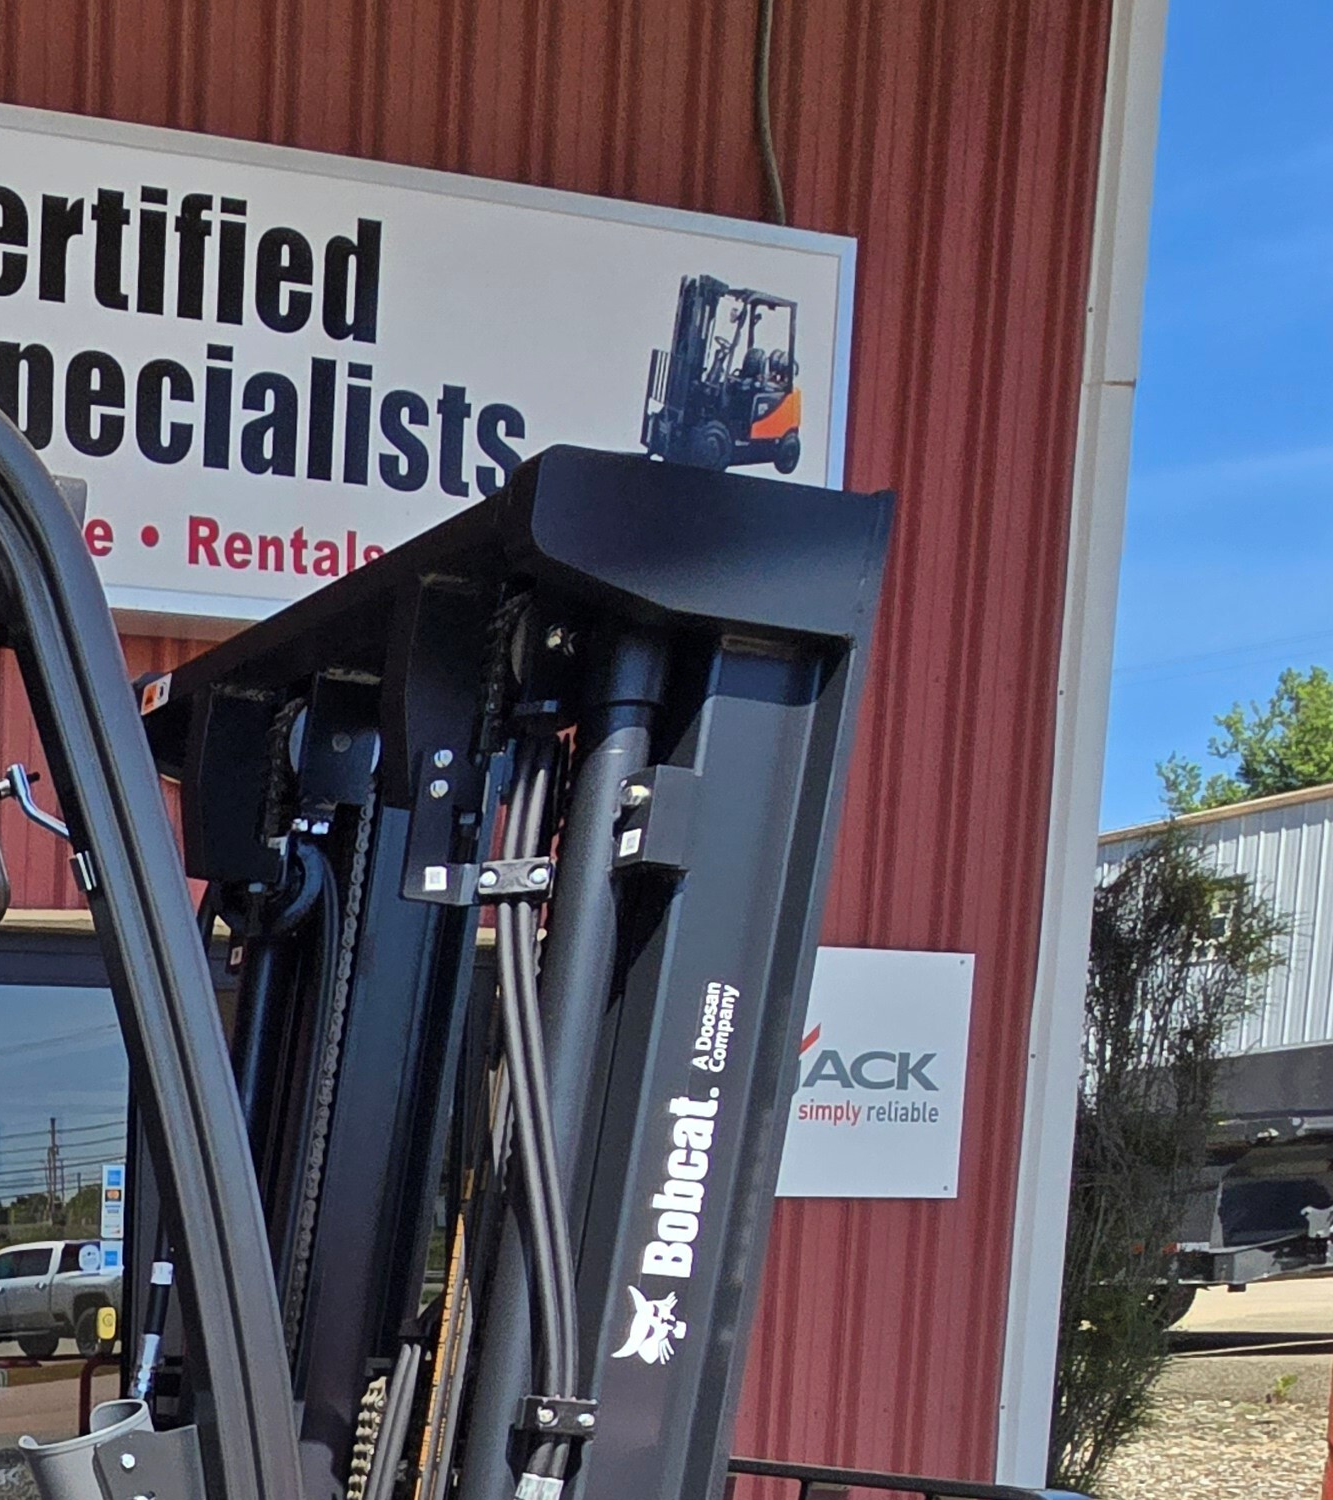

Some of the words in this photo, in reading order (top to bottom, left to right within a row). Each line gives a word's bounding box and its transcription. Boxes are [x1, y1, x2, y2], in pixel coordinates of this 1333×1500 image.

[695, 981, 722, 1051] Doosan
[708, 984, 740, 1073] Company
[692, 1056, 710, 1071] A
[798, 1098, 862, 1127] simply
[866, 1101, 939, 1122] reliable
